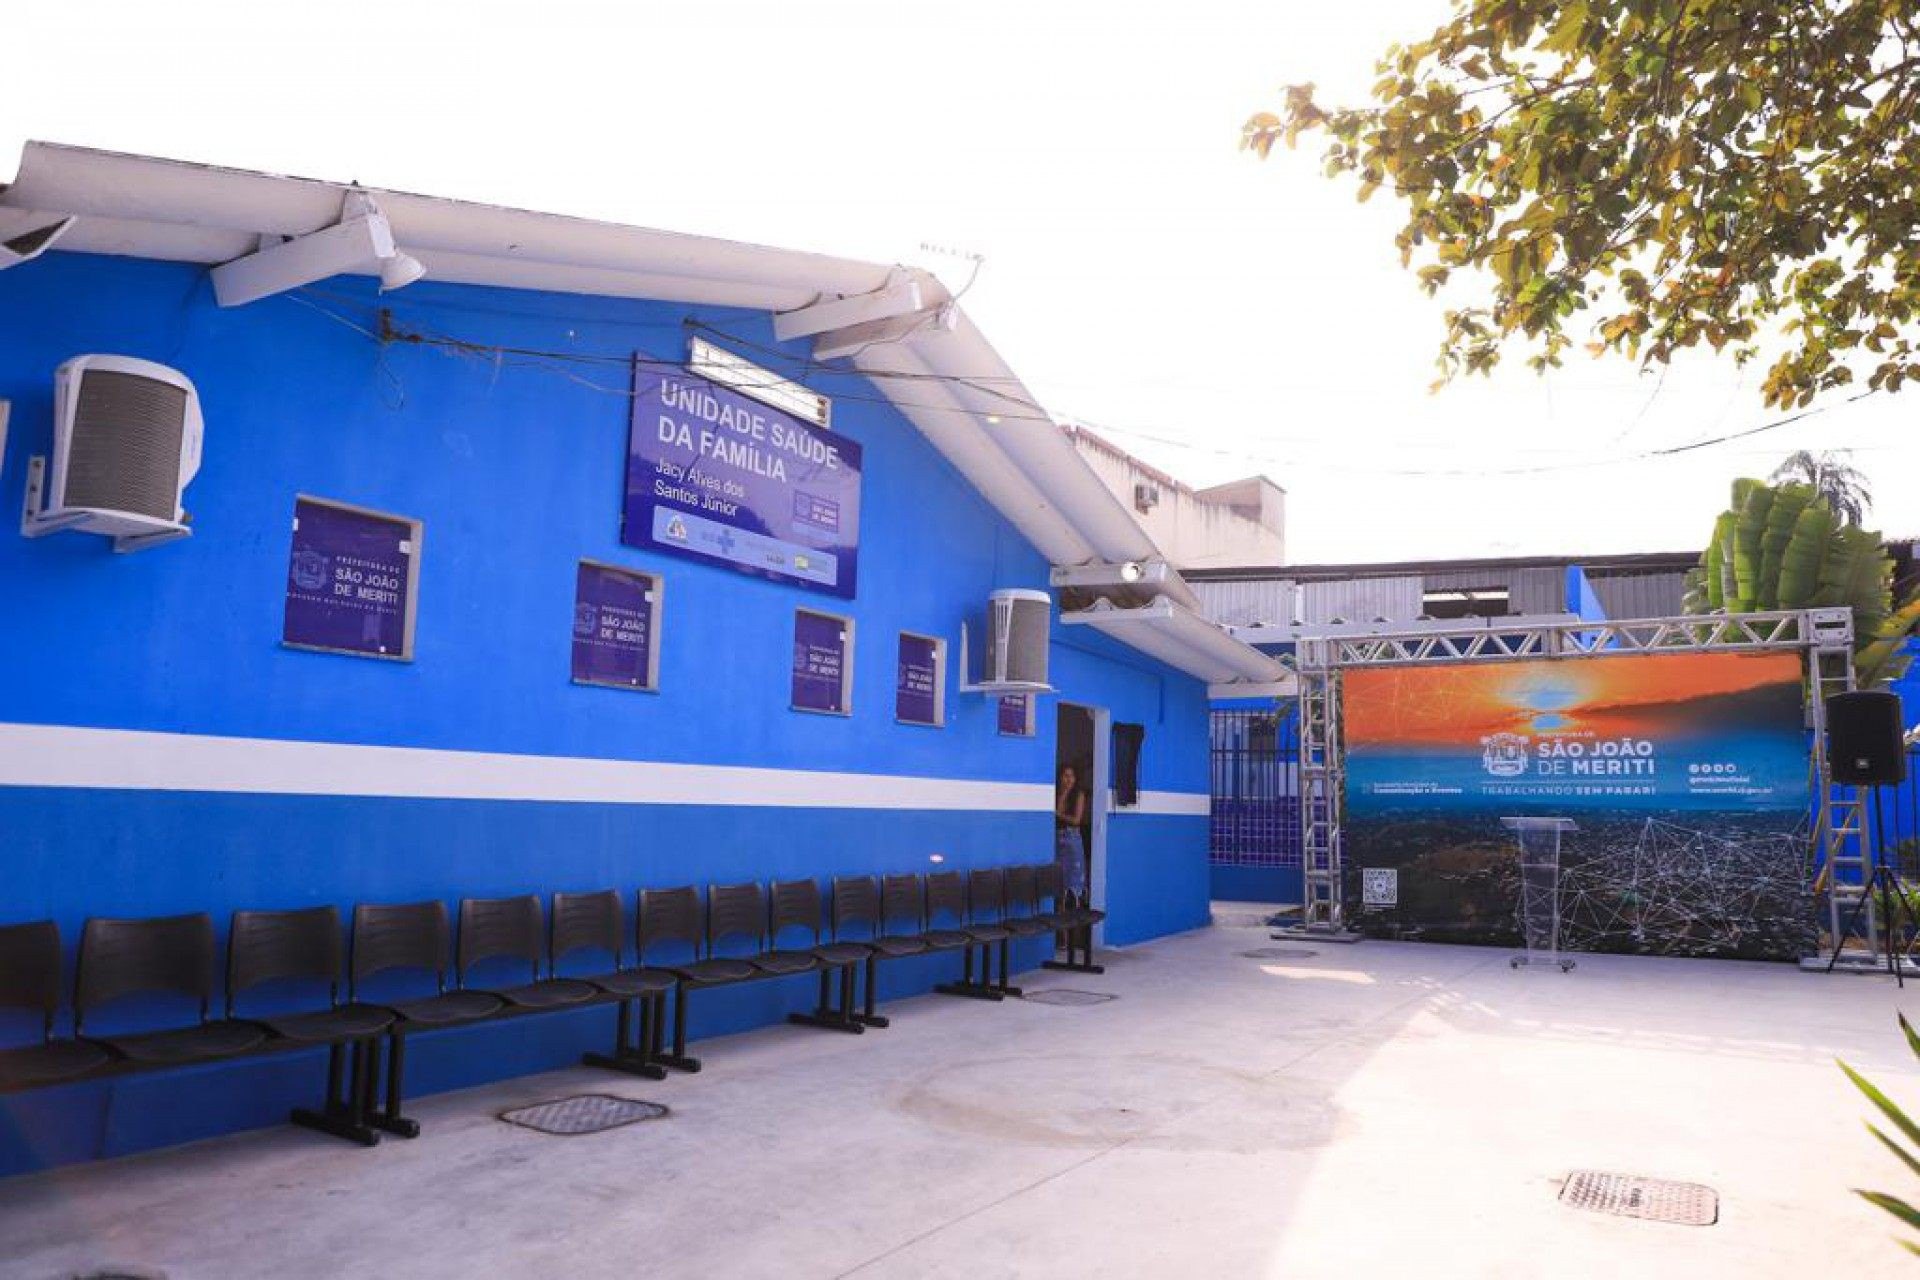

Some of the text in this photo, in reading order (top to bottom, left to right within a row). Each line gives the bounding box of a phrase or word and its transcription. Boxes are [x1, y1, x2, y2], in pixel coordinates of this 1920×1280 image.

[661, 378, 840, 470] UNIDADE SAÚDE
[659, 415, 787, 484] DA FAMÍLIA
[655, 457, 745, 498] Jacy Alves dos
[654, 479, 698, 506] Santos
[335, 567, 399, 590] SÃO JOÃO
[334, 582, 352, 597] DE
[357, 586, 398, 604] MERITI
[1538, 738, 1653, 757] SÃO JOÃO
[1538, 758, 1655, 775] DE MERITI
[1482, 786, 1573, 796] TRABALHANDO
[1576, 786, 1602, 796] SEM
